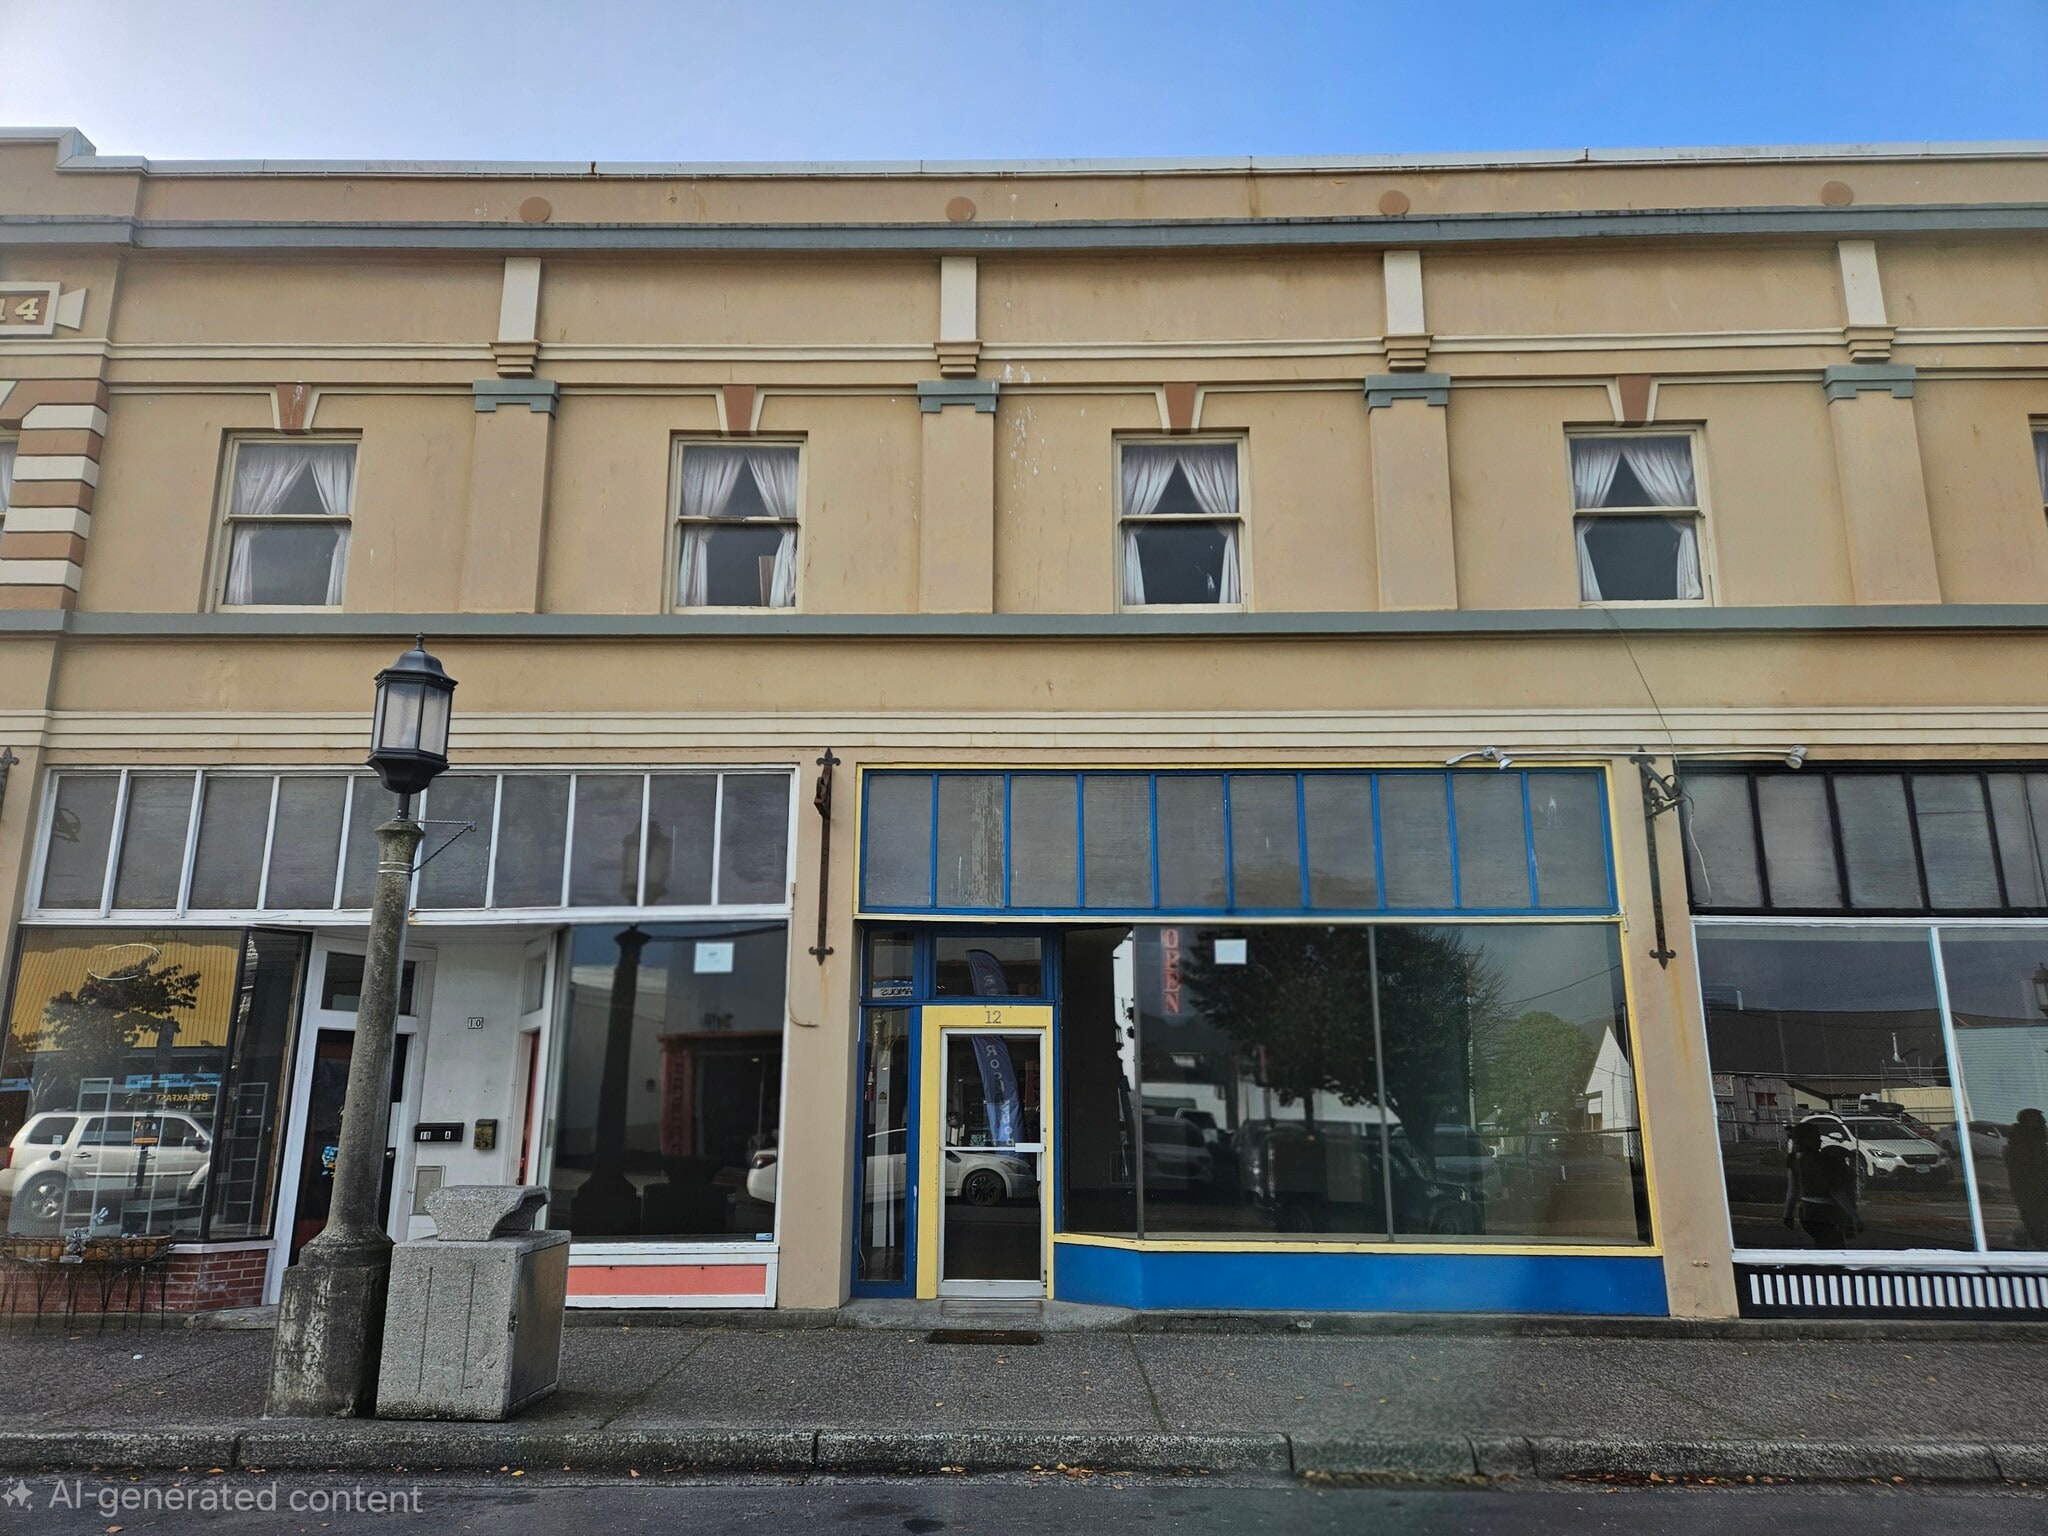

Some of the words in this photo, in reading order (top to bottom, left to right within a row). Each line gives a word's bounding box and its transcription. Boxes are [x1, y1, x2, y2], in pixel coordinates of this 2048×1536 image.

[1162, 928, 1180, 1014] OPEN
[469, 1018, 482, 1028] 10
[985, 1010, 1002, 1024] 12
[420, 1131, 431, 1140] 10
